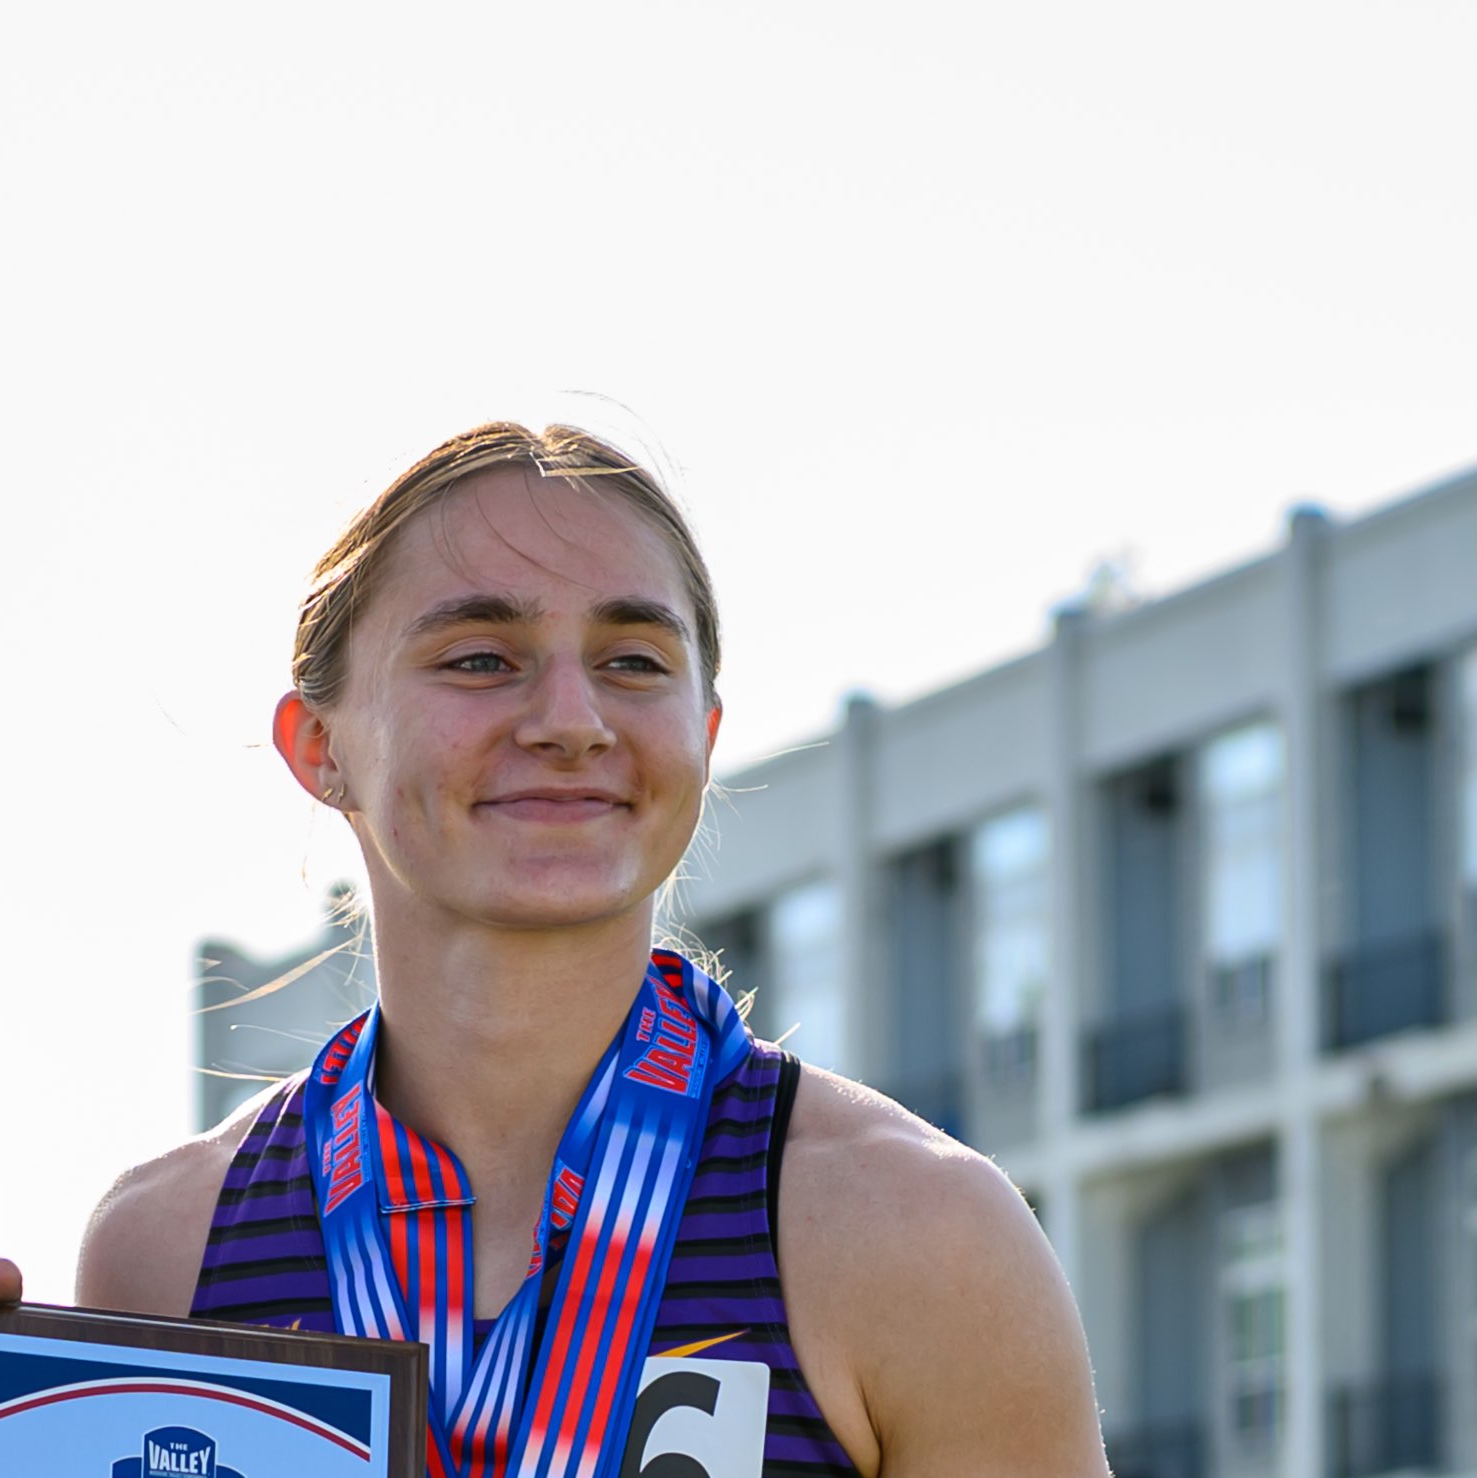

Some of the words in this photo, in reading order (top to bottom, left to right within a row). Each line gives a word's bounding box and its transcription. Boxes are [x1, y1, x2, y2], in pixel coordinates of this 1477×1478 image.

[636, 1006, 656, 1043] THE
[324, 1083, 363, 1217] VALLEY
[148, 1439, 212, 1475] VALLEY
[169, 1441, 189, 1452] THE
